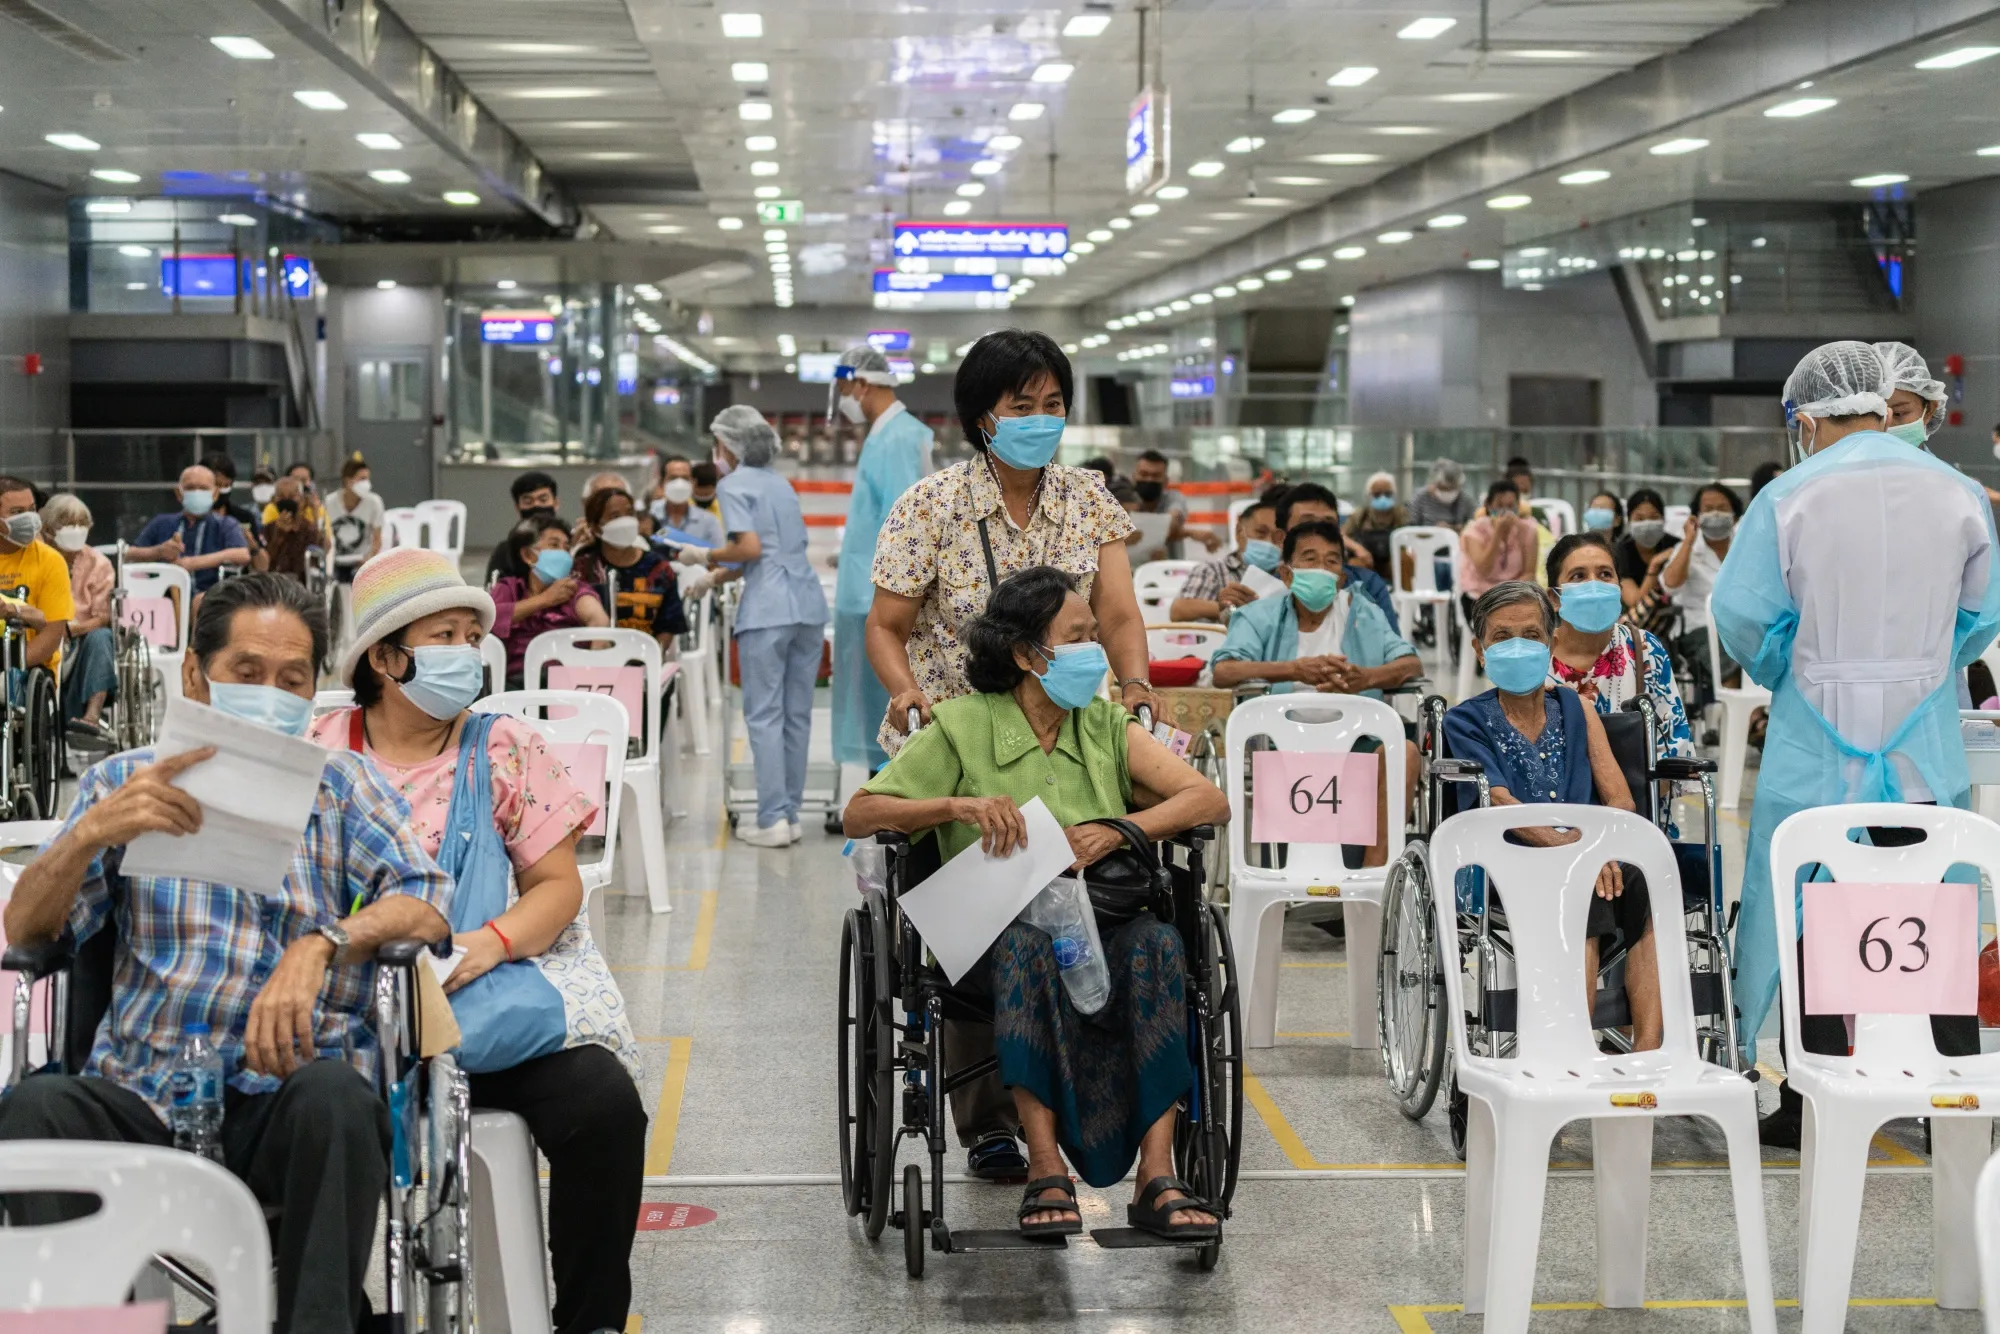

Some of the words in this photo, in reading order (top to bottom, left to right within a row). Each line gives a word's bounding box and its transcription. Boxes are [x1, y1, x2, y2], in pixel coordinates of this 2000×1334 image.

[131, 609, 154, 630] 91
[1290, 775, 1343, 815] 64
[1858, 916, 1930, 973] 63
[645, 1210, 664, 1223] AREA
[668, 1206, 691, 1227] WORKING
